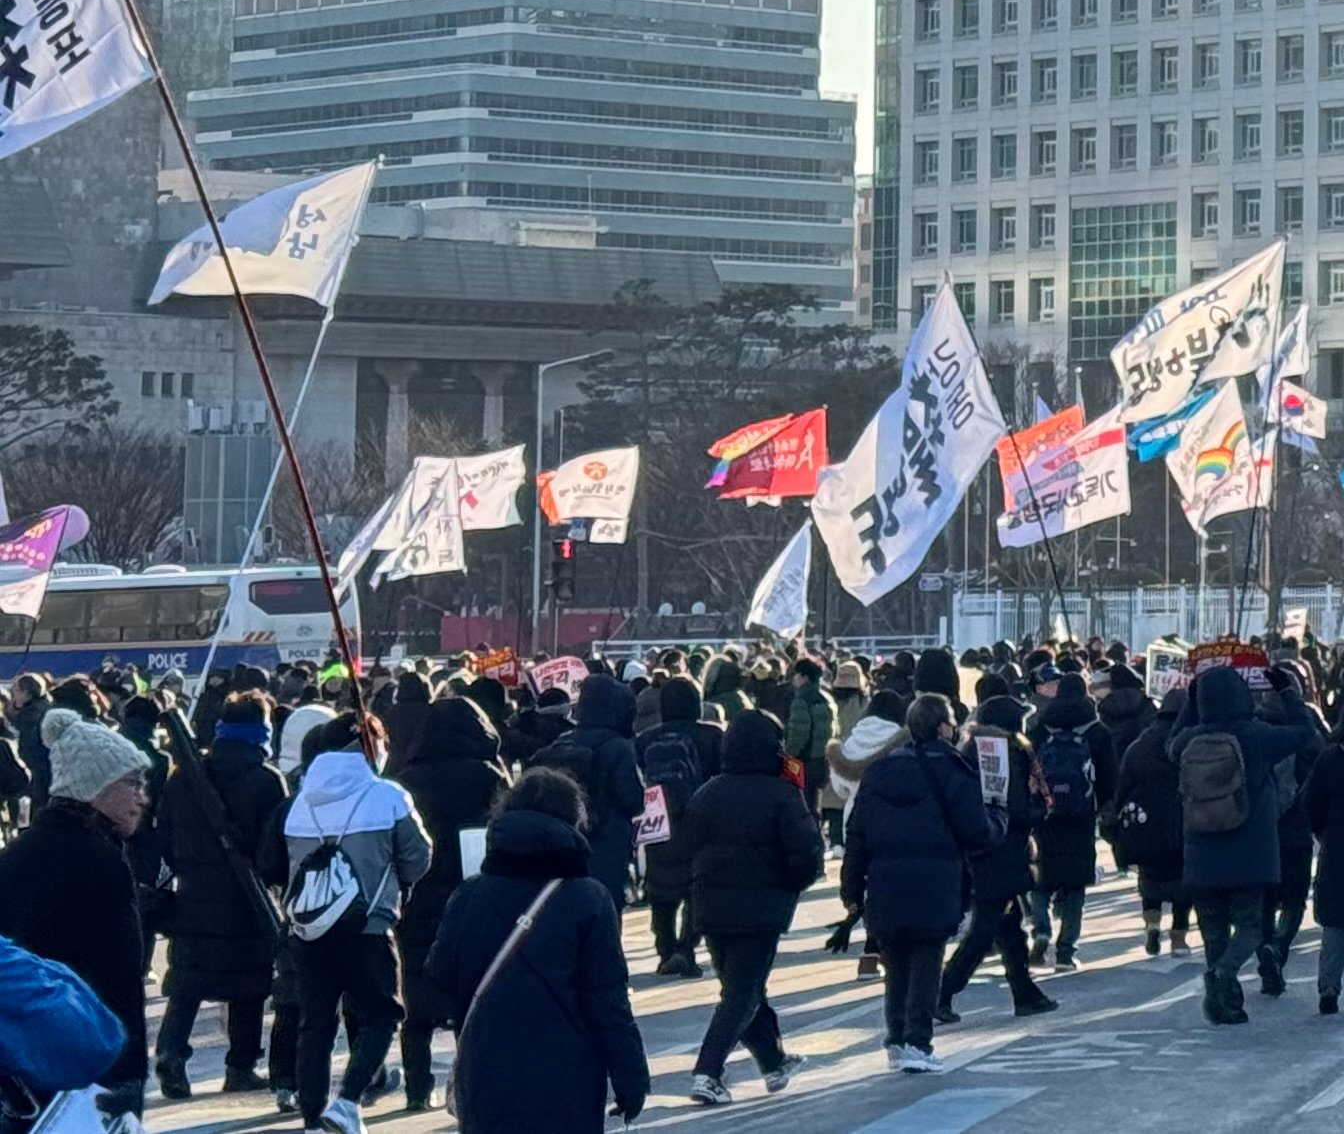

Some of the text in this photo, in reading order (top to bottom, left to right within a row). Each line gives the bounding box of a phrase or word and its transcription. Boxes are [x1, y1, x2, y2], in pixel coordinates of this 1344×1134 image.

[148, 652, 188, 669] POLICE
[288, 649, 321, 658] POLICE
[293, 851, 354, 913] NIKE
